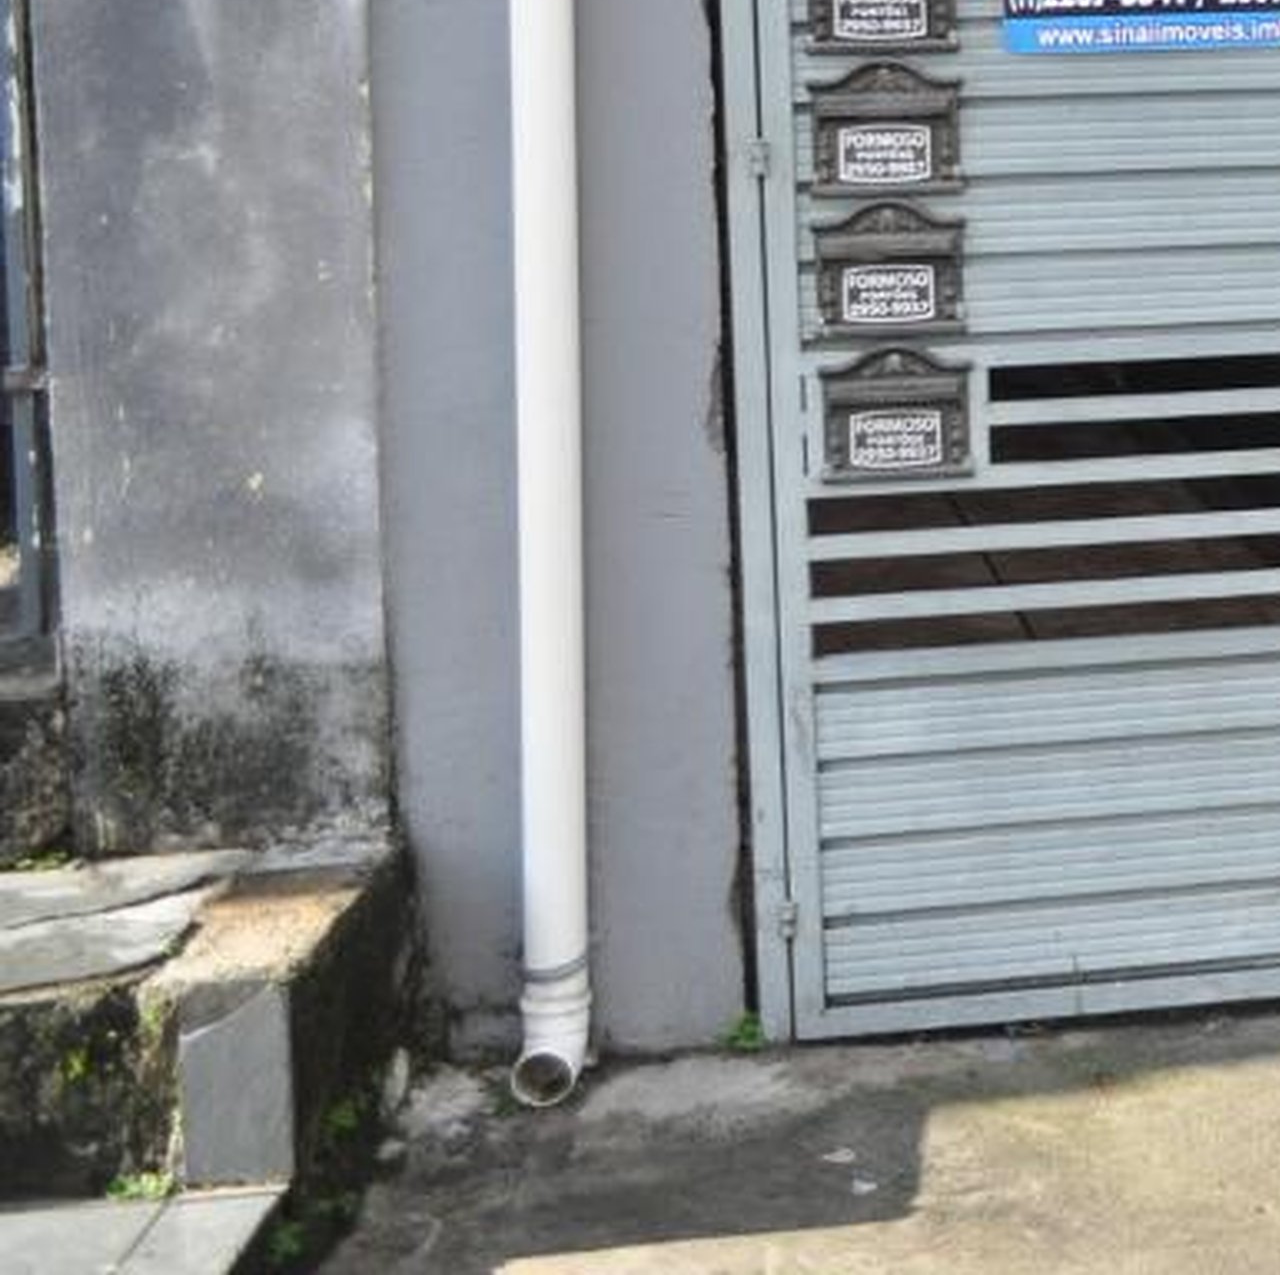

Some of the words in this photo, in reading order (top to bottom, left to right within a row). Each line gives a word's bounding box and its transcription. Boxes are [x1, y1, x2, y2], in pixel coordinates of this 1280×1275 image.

[846, 132, 924, 148] FORMOSO
[850, 272, 927, 288] FORMOSO
[856, 417, 935, 433] FORMOSO
